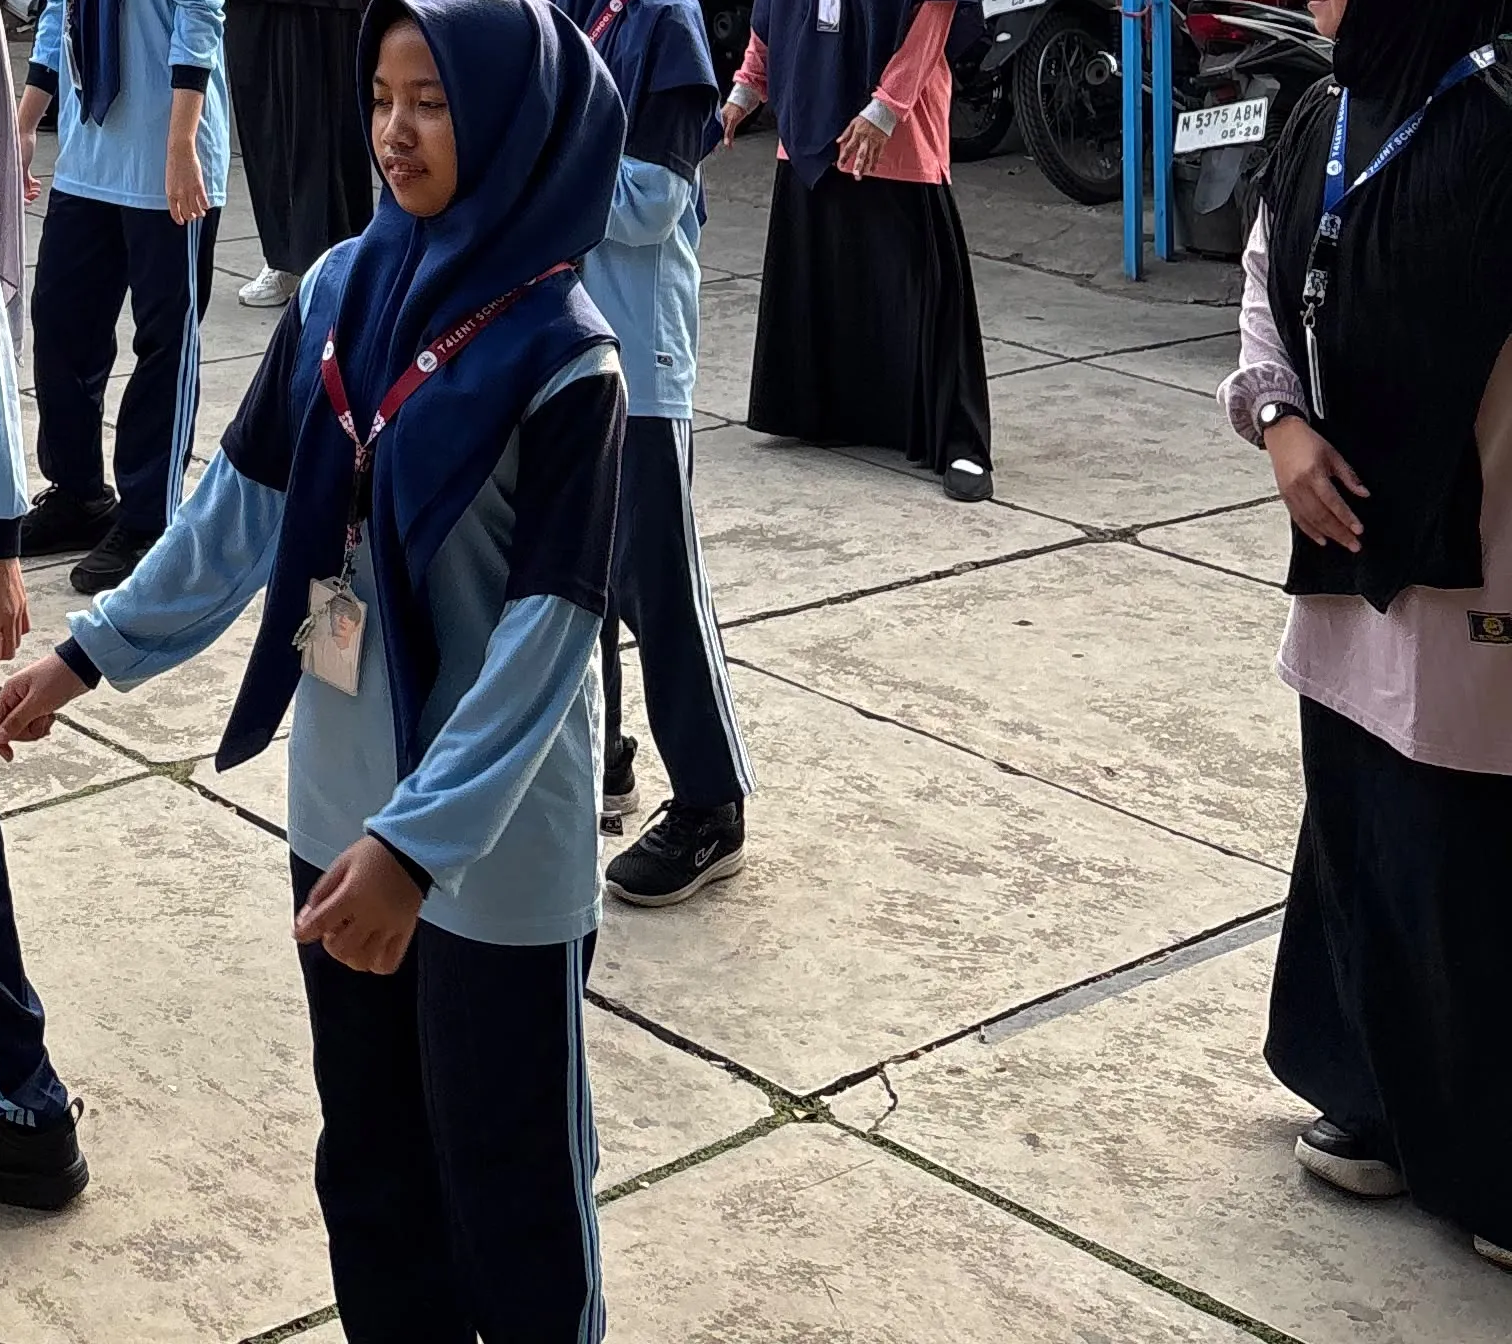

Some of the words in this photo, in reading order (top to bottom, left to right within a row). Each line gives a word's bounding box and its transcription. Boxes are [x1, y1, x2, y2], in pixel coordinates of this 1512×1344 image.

[1181, 116, 1191, 132] N
[1195, 108, 1230, 129] 5375
[1233, 102, 1263, 122] ABM
[437, 318, 476, 354] T4LENT
